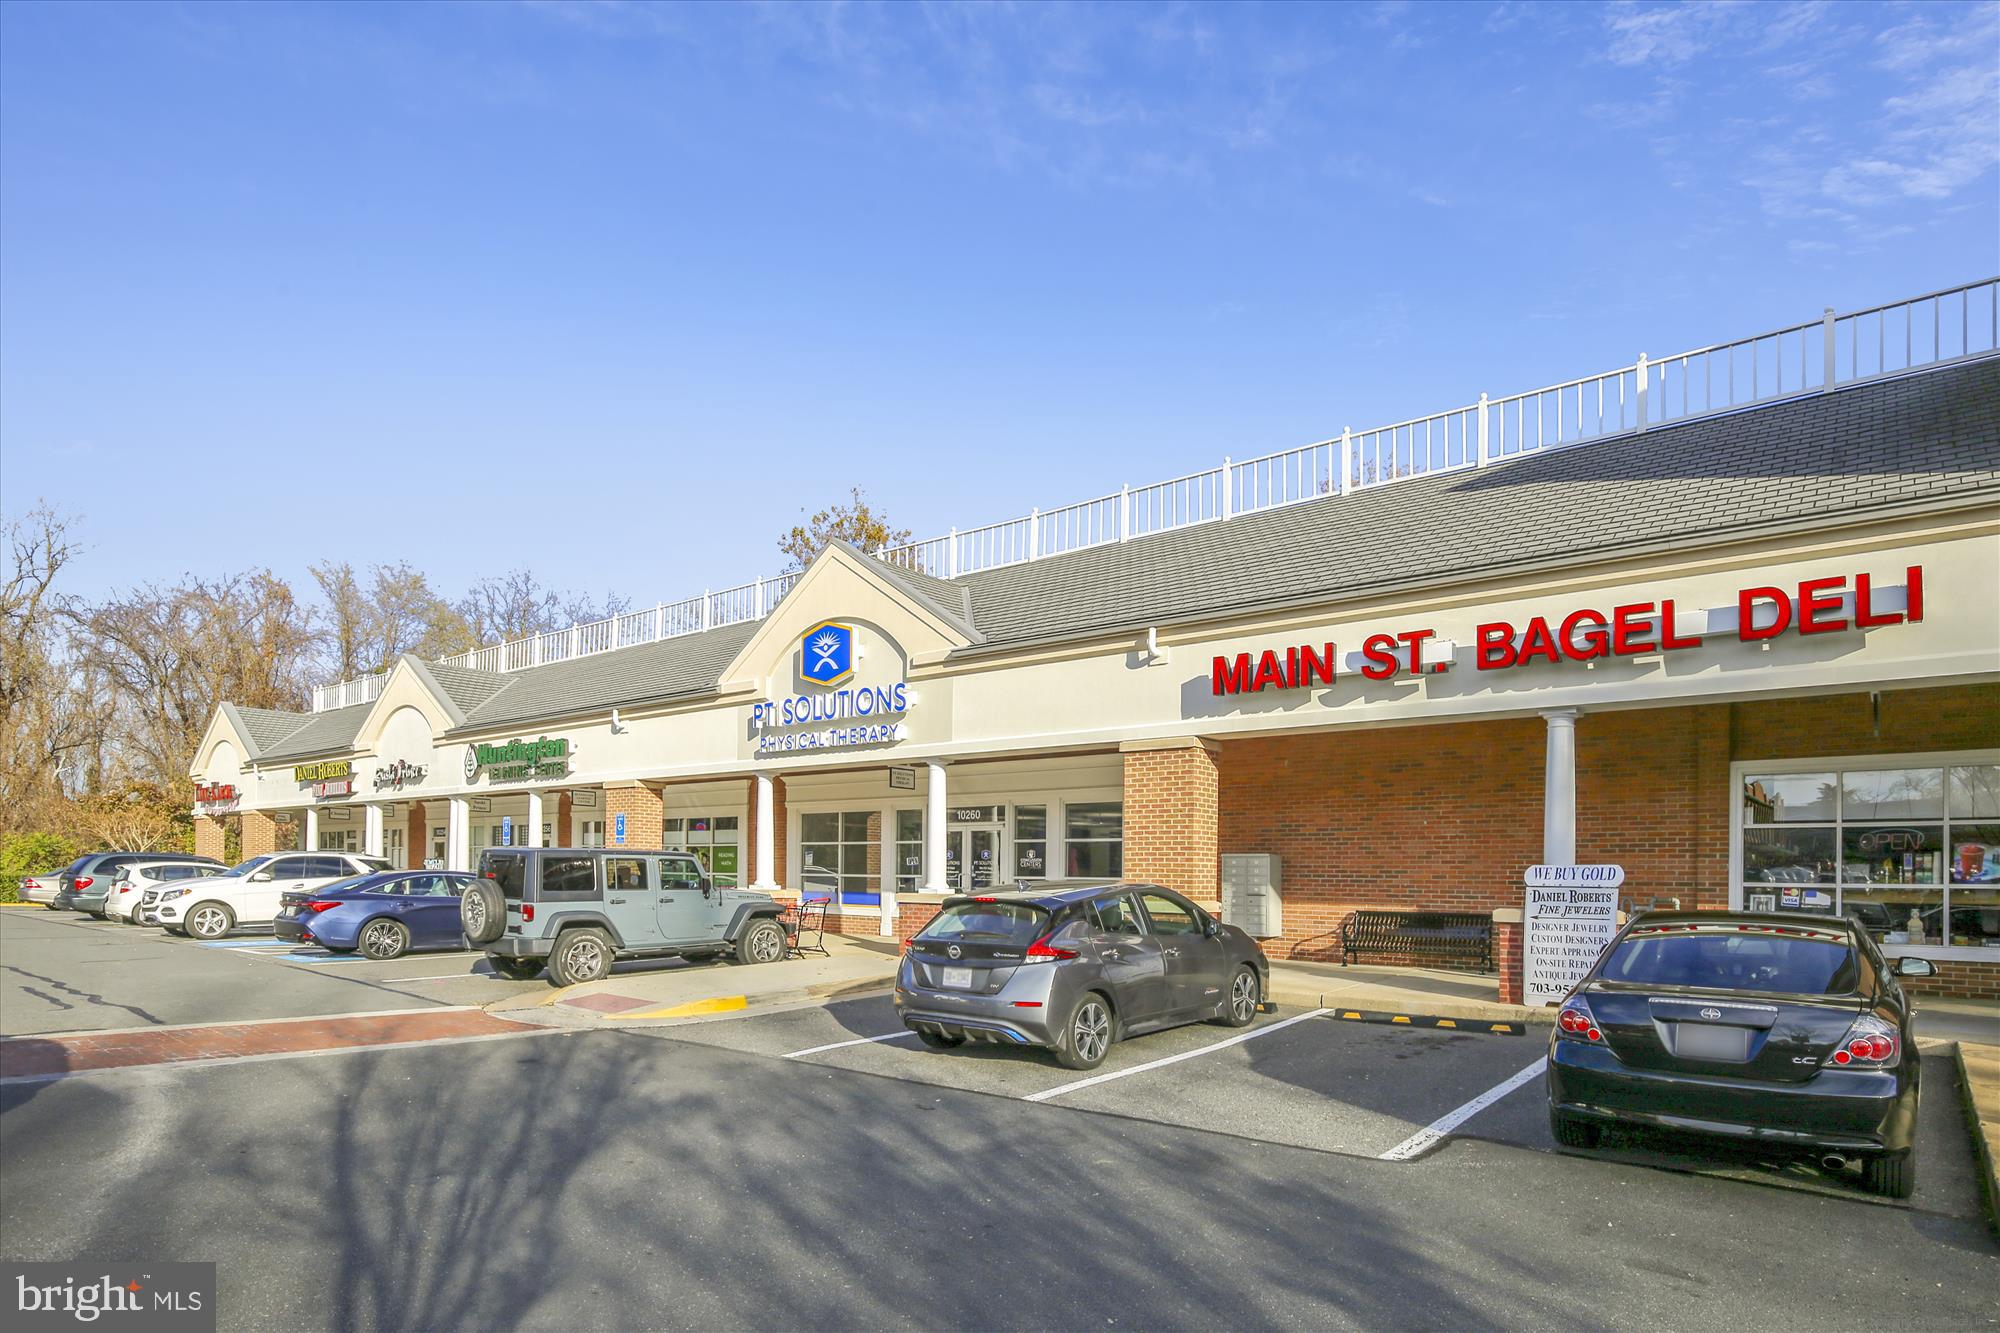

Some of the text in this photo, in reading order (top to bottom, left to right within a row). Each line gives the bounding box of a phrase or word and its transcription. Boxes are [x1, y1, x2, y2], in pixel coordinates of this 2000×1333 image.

[1212, 565, 1924, 696] MAIN ST. BAGEL DELI
[753, 683, 907, 728] PT SOLUTIONS
[760, 724, 899, 751] PHYSICAL THERAPY
[478, 736, 566, 767] Huntington
[295, 761, 348, 782] DANIEL ROBERTS
[956, 810, 981, 820] 10260
[1859, 833, 1921, 850] OPEN
[1534, 867, 1616, 880] WE BUY GOLD
[1532, 889, 1612, 903] DANIEL ROBERTS
[1538, 904, 1611, 917] FINE JEWELERS
[1531, 922, 1608, 933] DESIGNER JEWELRY
[1531, 934, 1610, 945] CUSTOM DESIGNERS
[1530, 945, 1601, 957] EXPERT APPRAISA
[1536, 958, 1566, 968] ON-SITE
[1533, 970, 1585, 981] ANTIQUE JEW
[1530, 983, 1573, 995] 703-95
